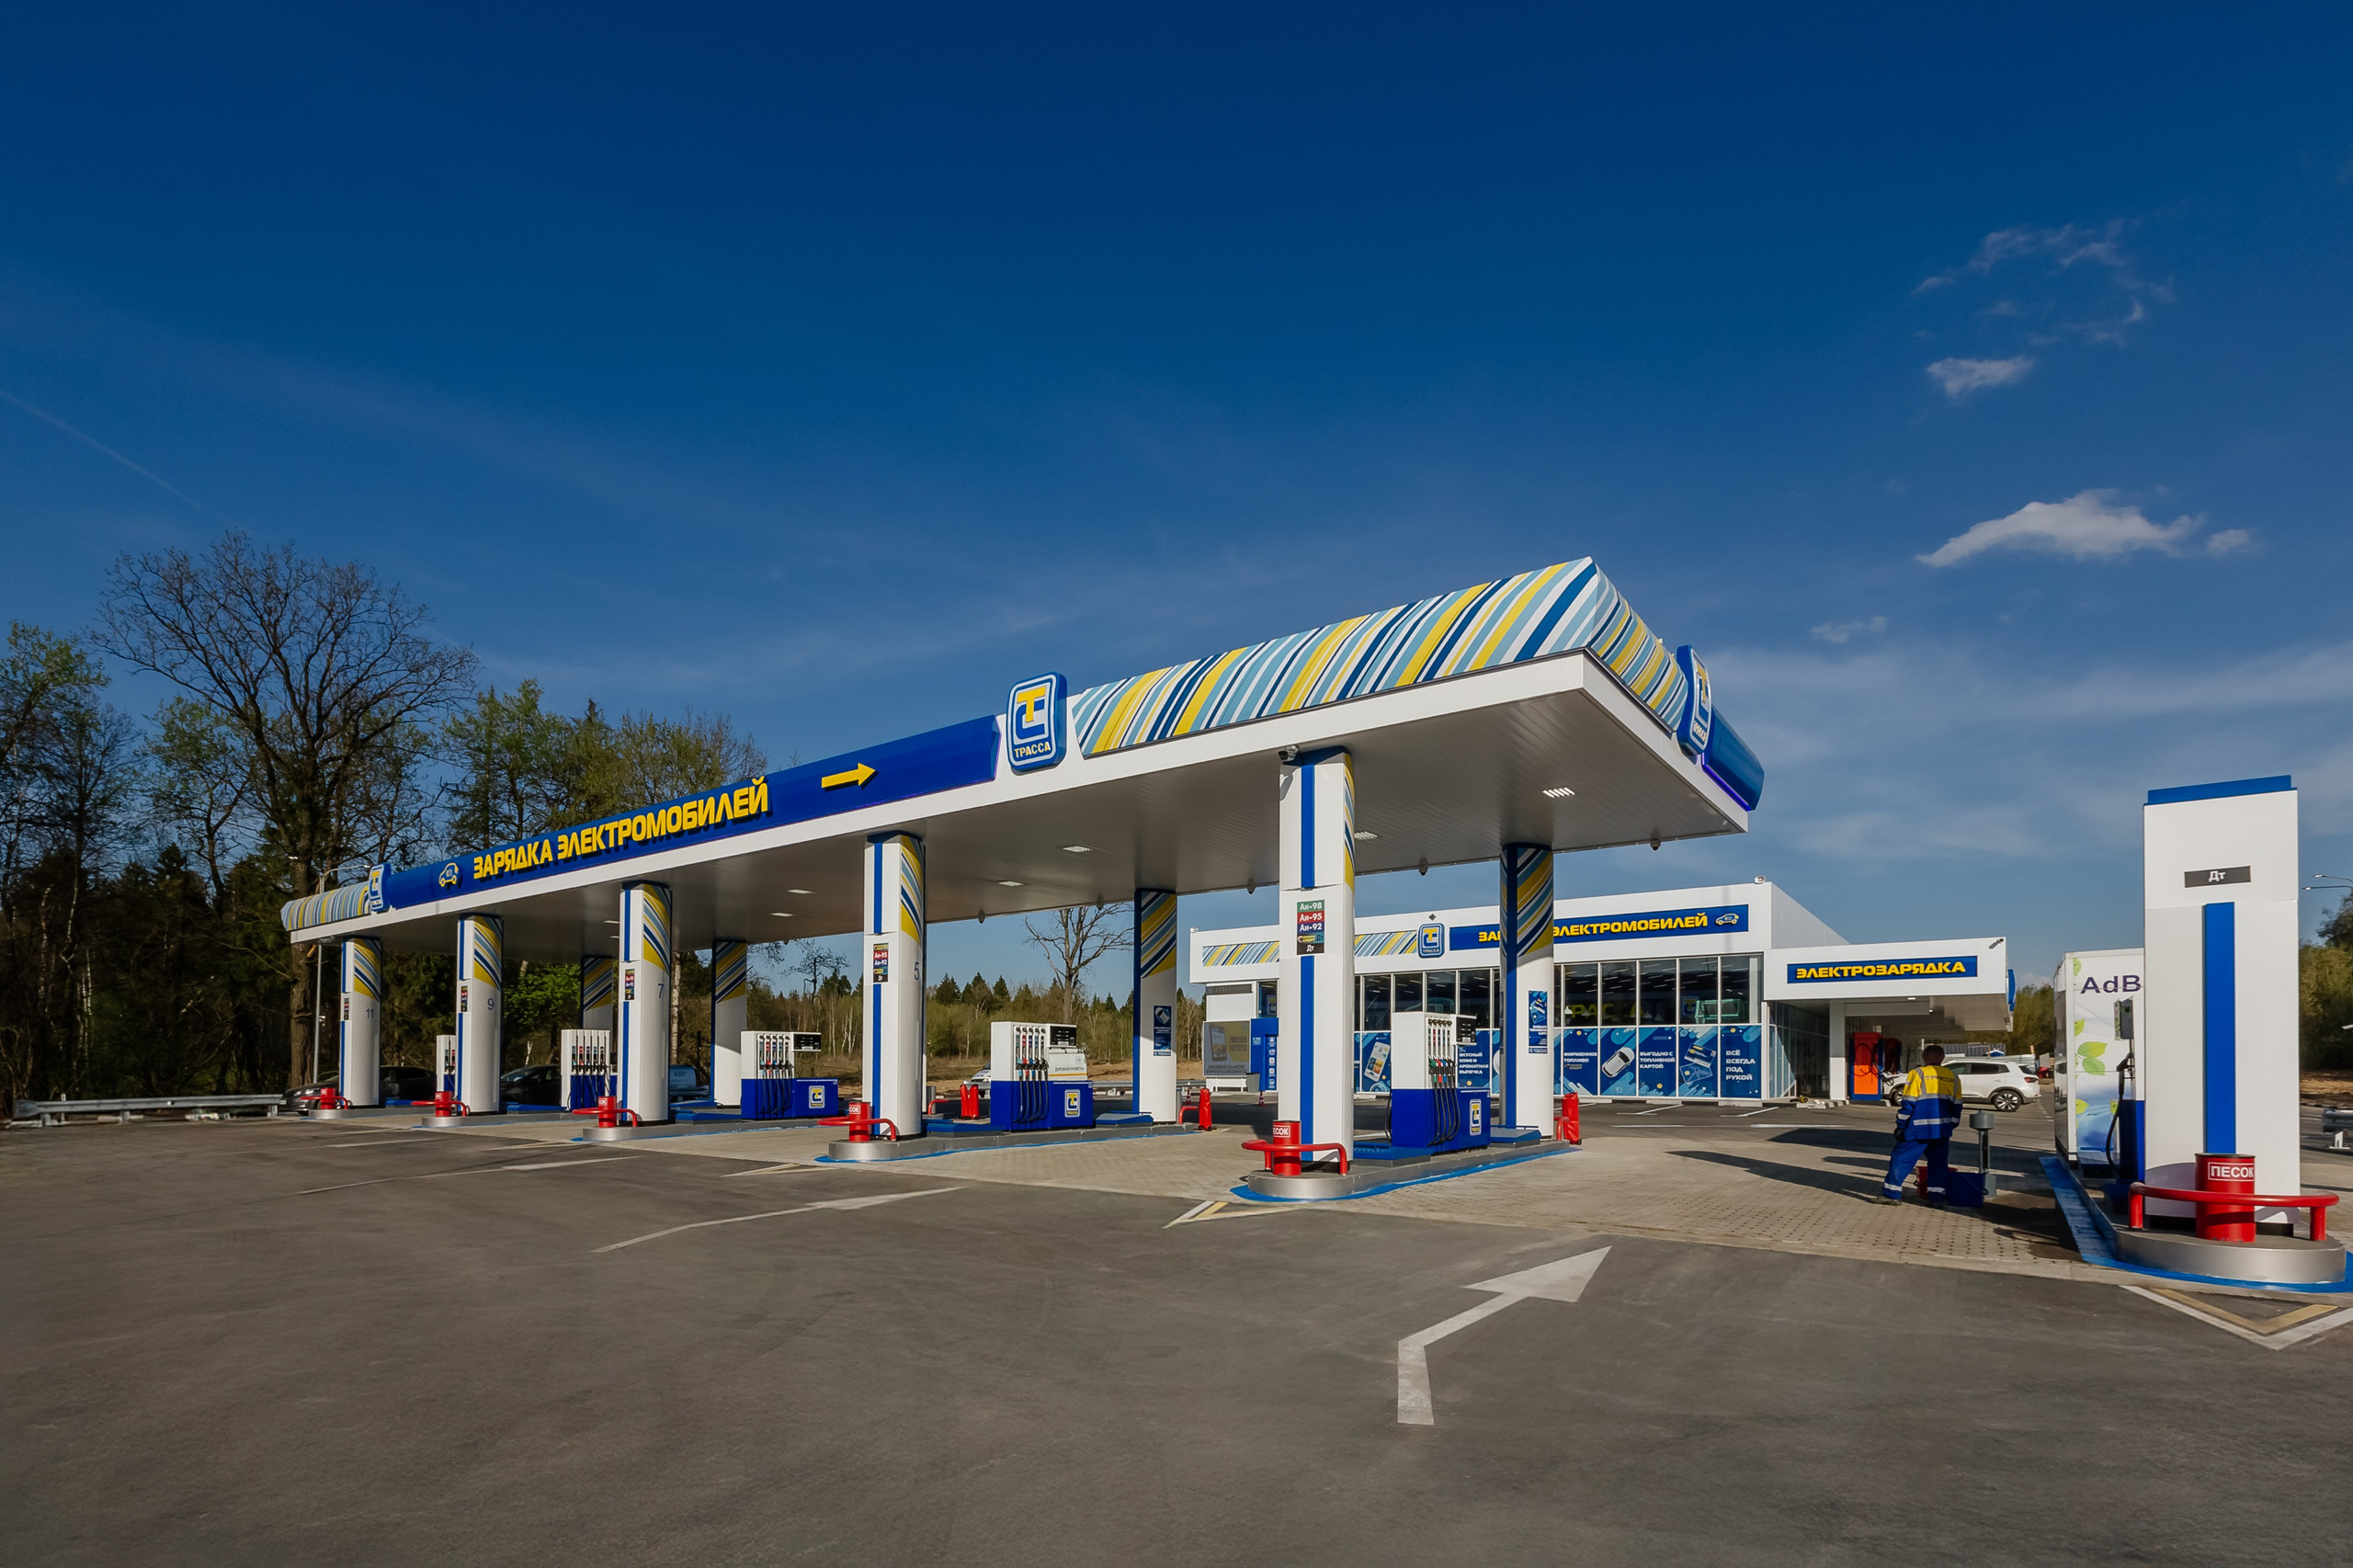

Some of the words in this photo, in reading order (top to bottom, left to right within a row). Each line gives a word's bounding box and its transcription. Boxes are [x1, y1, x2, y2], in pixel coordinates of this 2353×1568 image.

[1014, 741, 1051, 758] ТРАССА
[473, 839, 552, 880] ЗАРЯДКА
[557, 776, 768, 859] ЭЛЕКТРОМОБИЛЕЙ
[2208, 870, 2226, 882] Дт
[1299, 902, 1323, 911] Аи-98
[1299, 912, 1323, 922] Аи-95
[1299, 922, 1323, 932] Аи-92
[1552, 913, 1709, 937] ЭЛЕКТРОМОБИЛЕЙ
[1306, 944, 1315, 952] Дт
[914, 961, 919, 981] 5
[1796, 961, 1966, 979] ЭЛЕКТРОЗАРЯДКА
[657, 983, 665, 999] 7
[487, 997, 494, 1011] 9
[365, 1007, 374, 1019] 11
[2211, 1165, 2255, 1178] ПЕСОК
